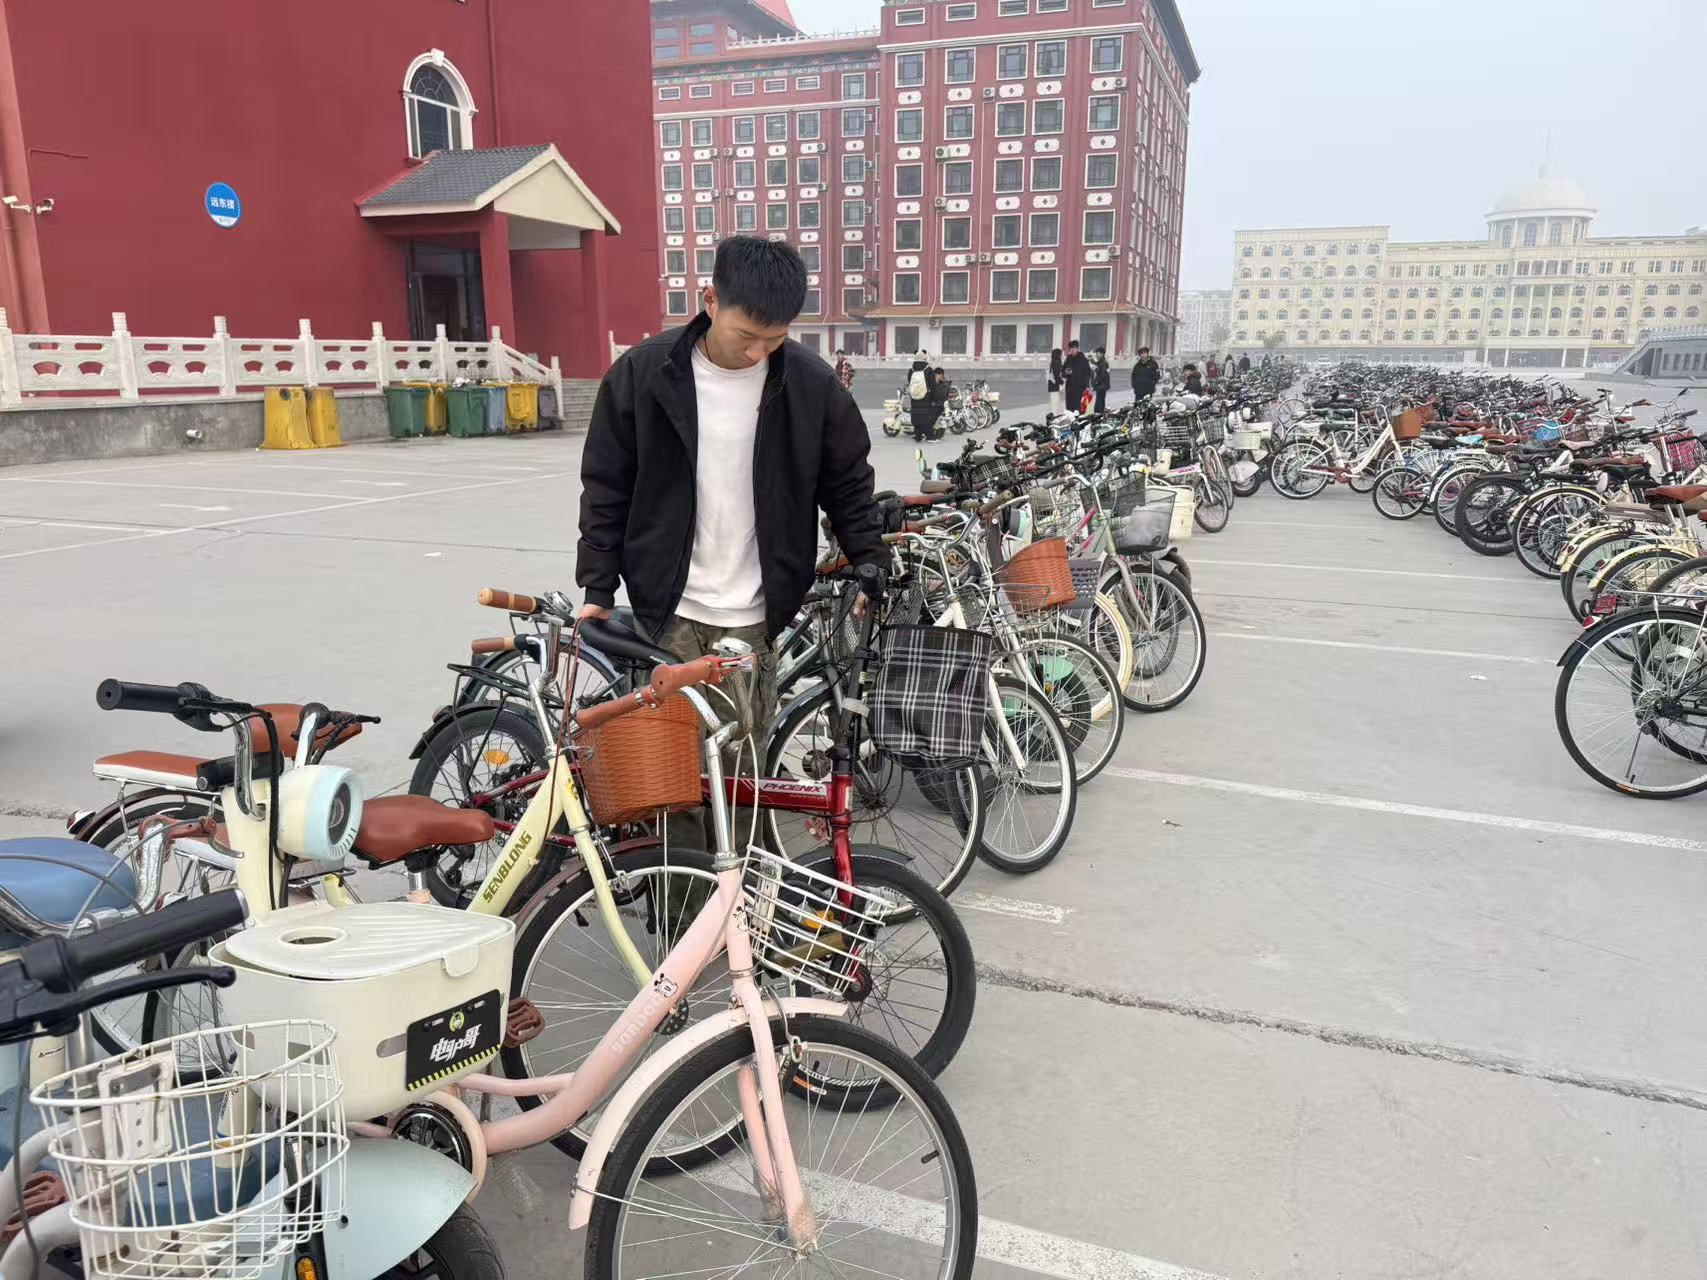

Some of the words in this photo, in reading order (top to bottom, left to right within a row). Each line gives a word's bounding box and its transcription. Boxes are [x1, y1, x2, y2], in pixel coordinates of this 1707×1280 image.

[762, 782, 823, 793] PHOENIX
[482, 830, 533, 904] SENBLONG
[429, 1023, 482, 1062] 电驴哥
